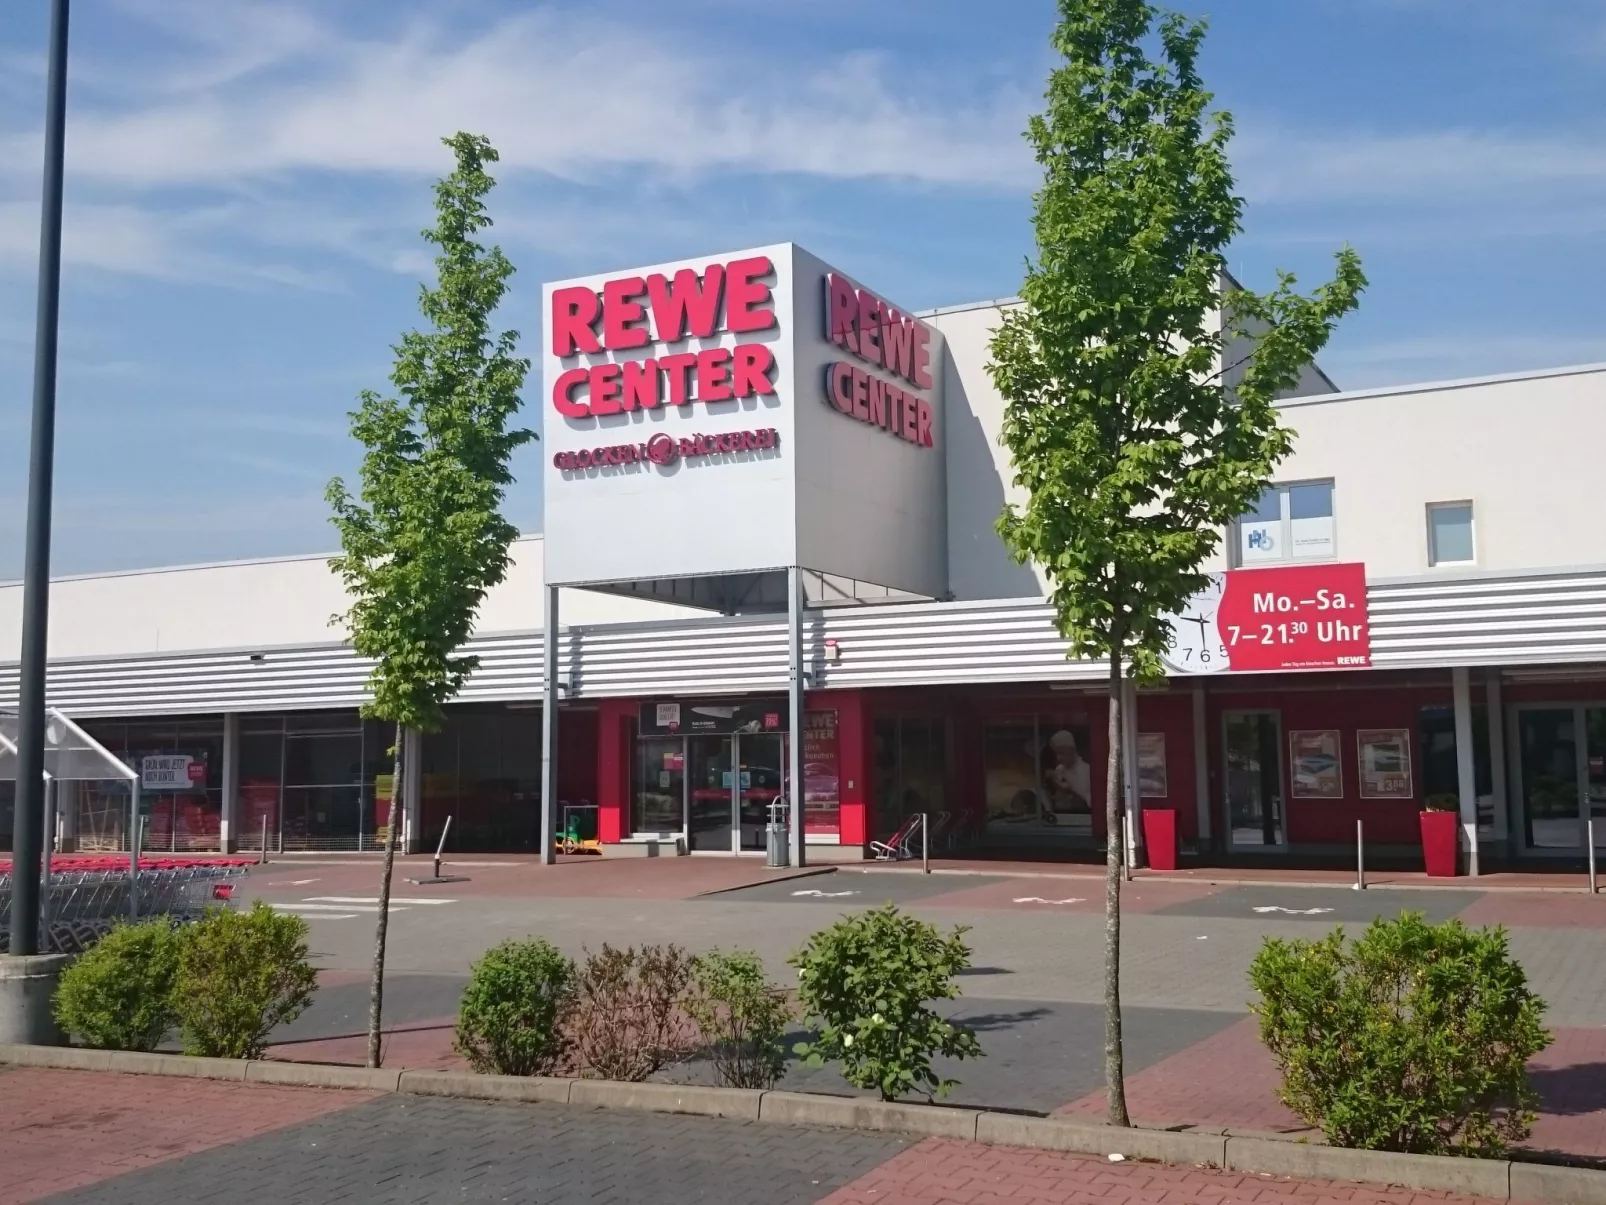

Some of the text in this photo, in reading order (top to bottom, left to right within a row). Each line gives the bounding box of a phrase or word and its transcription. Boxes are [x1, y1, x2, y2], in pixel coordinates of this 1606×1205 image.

[552, 256, 776, 358] REWE
[826, 273, 932, 390] REWE
[553, 343, 776, 418] CENTER
[827, 361, 933, 448] CENTER
[553, 428, 777, 469] GLOCKEN BÄCKEREI
[1317, 619, 1363, 642] Uhr
[1337, 656, 1366, 665] REWE
